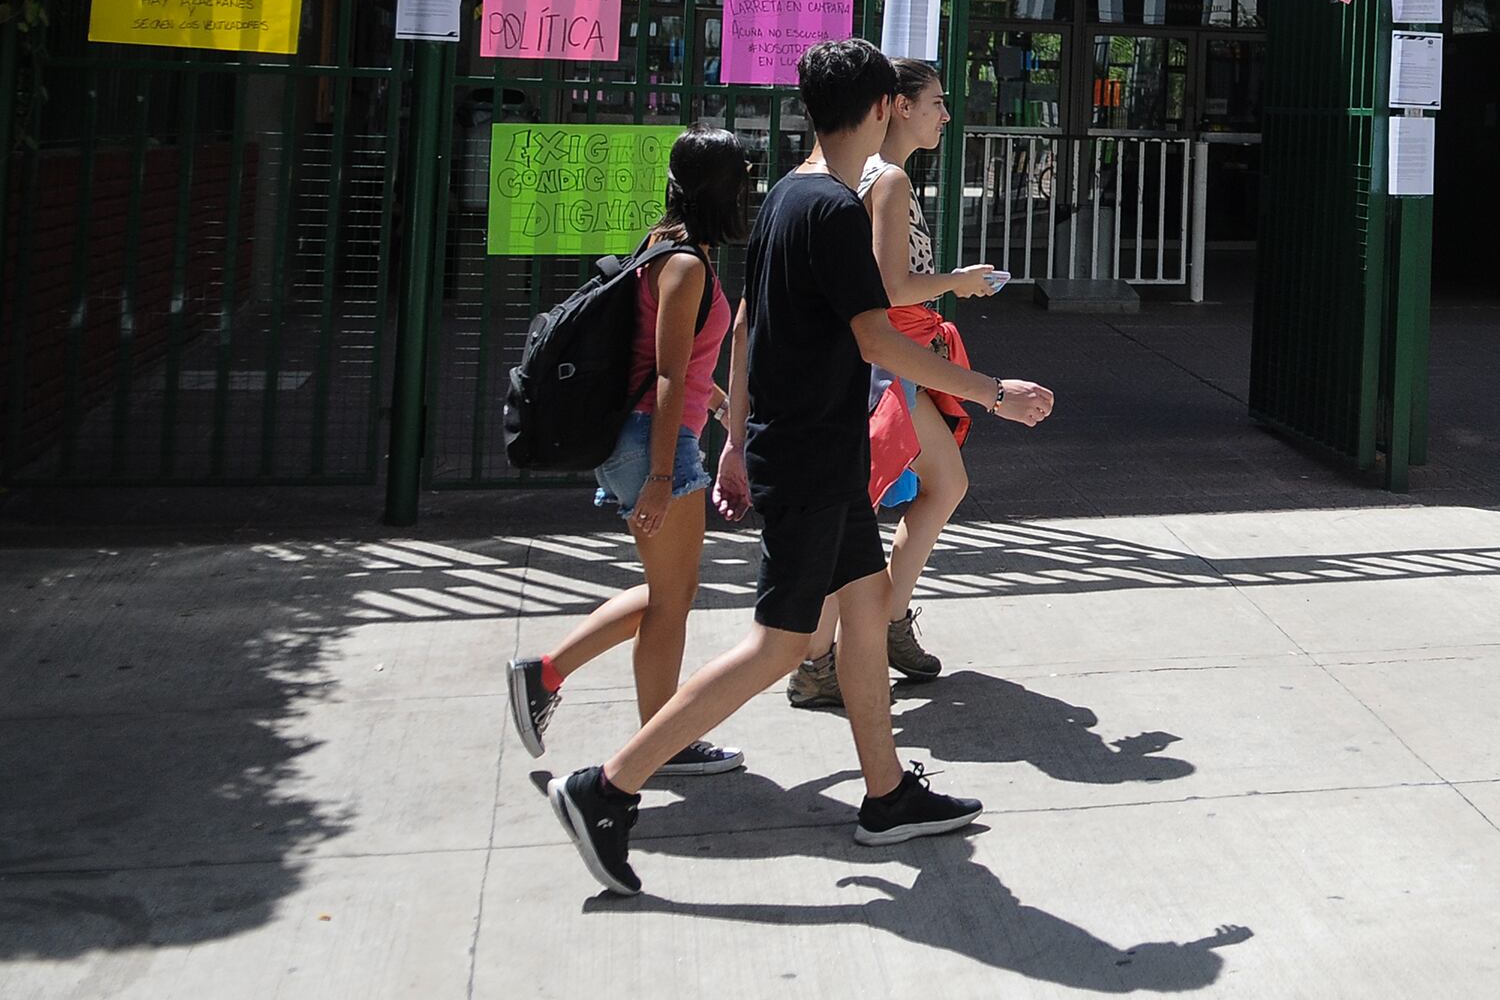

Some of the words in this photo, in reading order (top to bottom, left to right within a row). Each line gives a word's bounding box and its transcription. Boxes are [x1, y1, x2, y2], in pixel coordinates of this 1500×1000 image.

[188, 7, 196, 16] Y
[787, 1, 802, 13] EN
[808, 0, 851, 14] CAMPAÑA
[179, 20, 199, 30] LOS
[488, 6, 604, 53] POLÍTICA
[769, 29, 781, 39] NO
[786, 29, 829, 39] ESCUCHA
[758, 56, 773, 67] EN
[523, 199, 664, 237] DIGNAS
